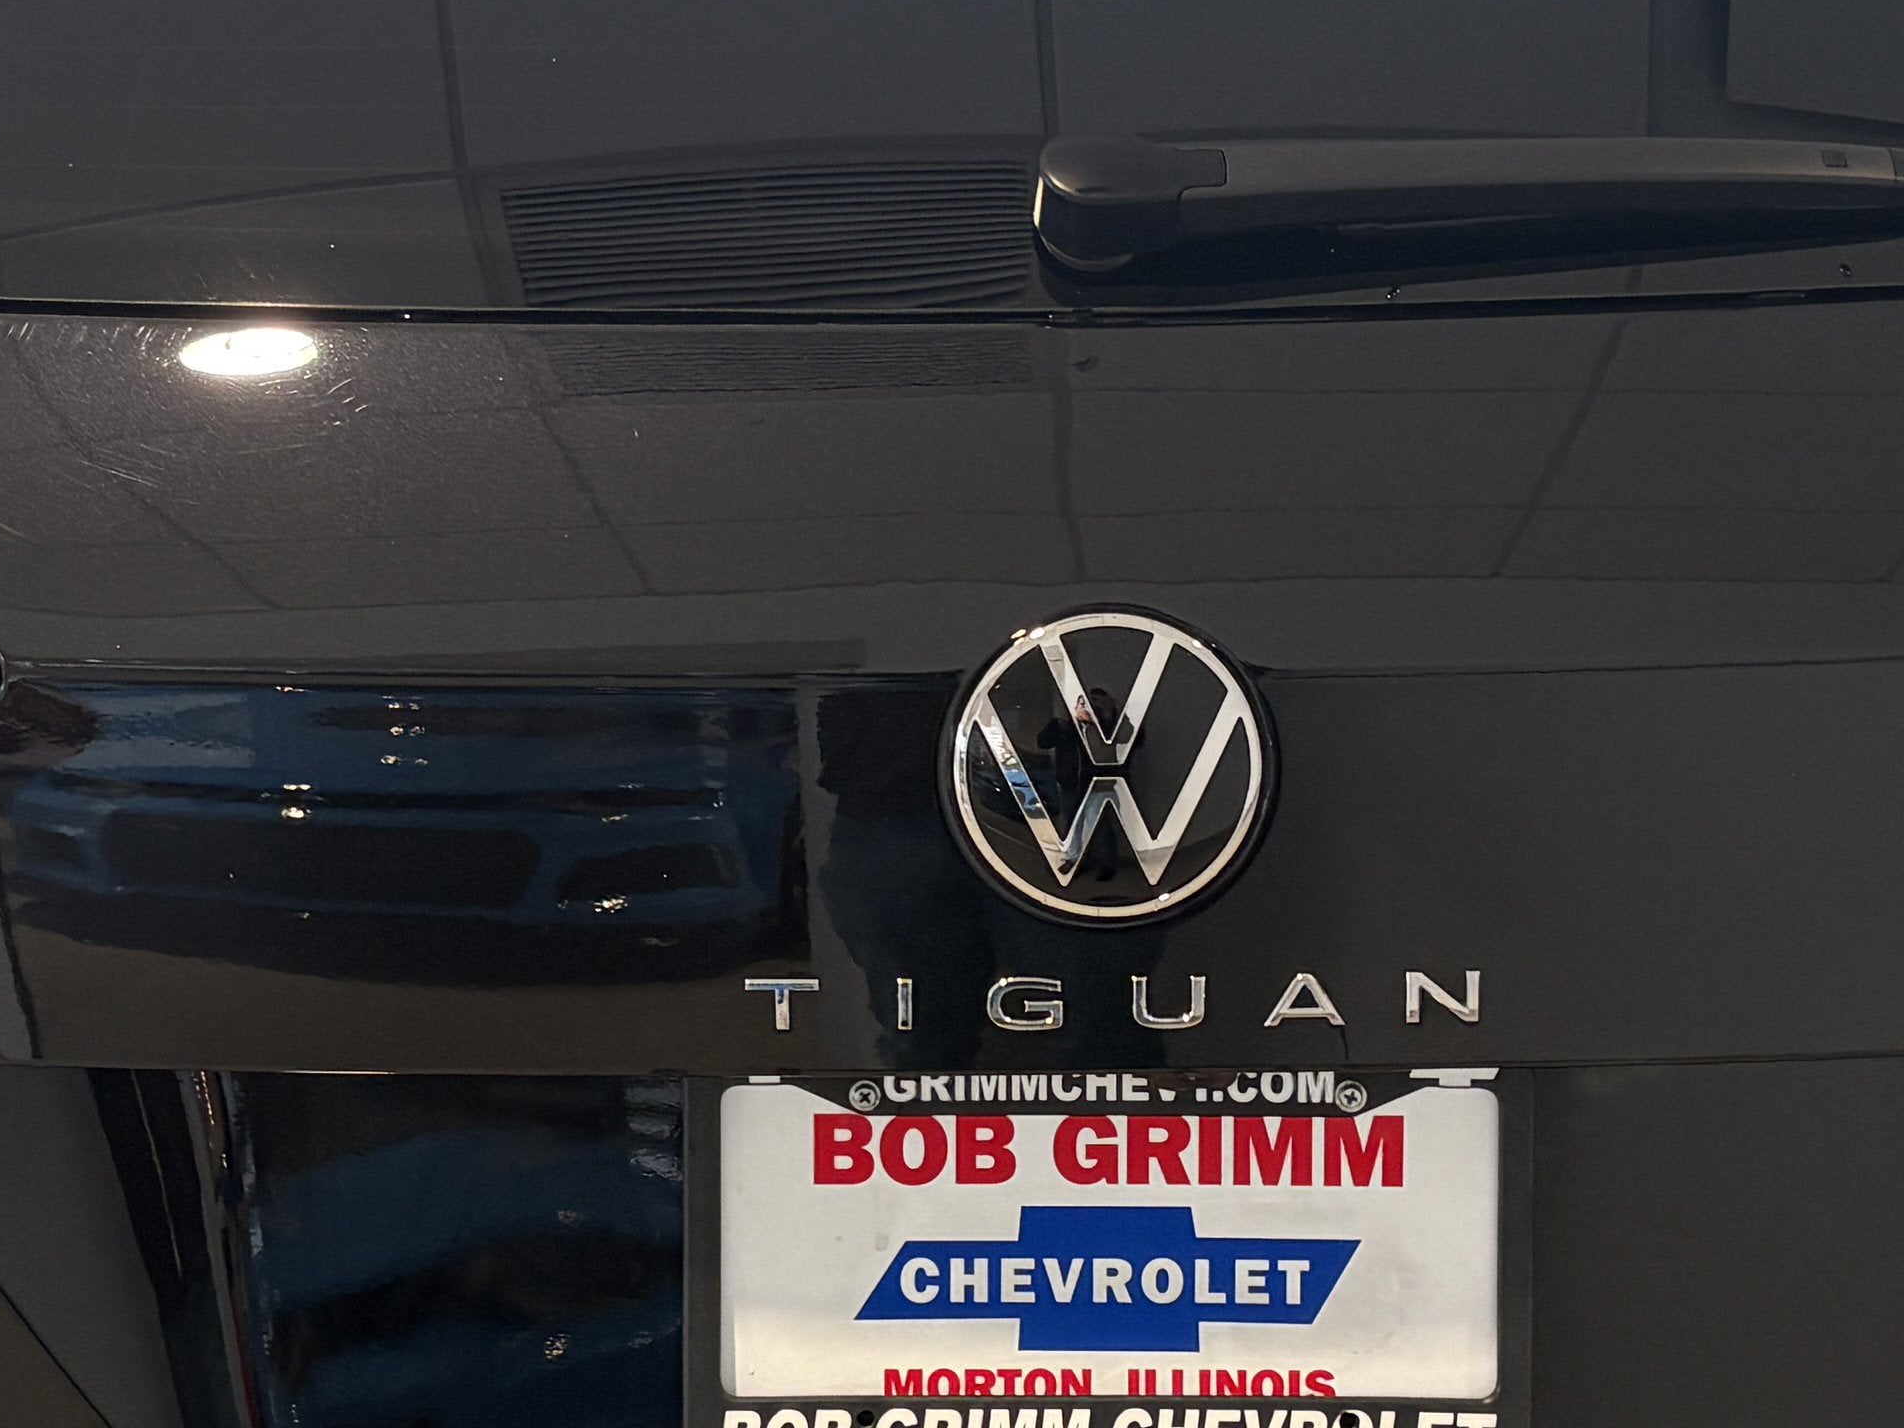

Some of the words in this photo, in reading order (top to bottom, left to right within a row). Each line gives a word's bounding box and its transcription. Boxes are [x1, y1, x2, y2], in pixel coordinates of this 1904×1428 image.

[744, 970, 1482, 1032] TIGUAN
[883, 1071, 1336, 1104] GRIMMCHE.COM
[813, 1113, 1017, 1185] BOB
[1052, 1114, 1405, 1188] GRIMM
[899, 1257, 1311, 1305] CHEVROLET
